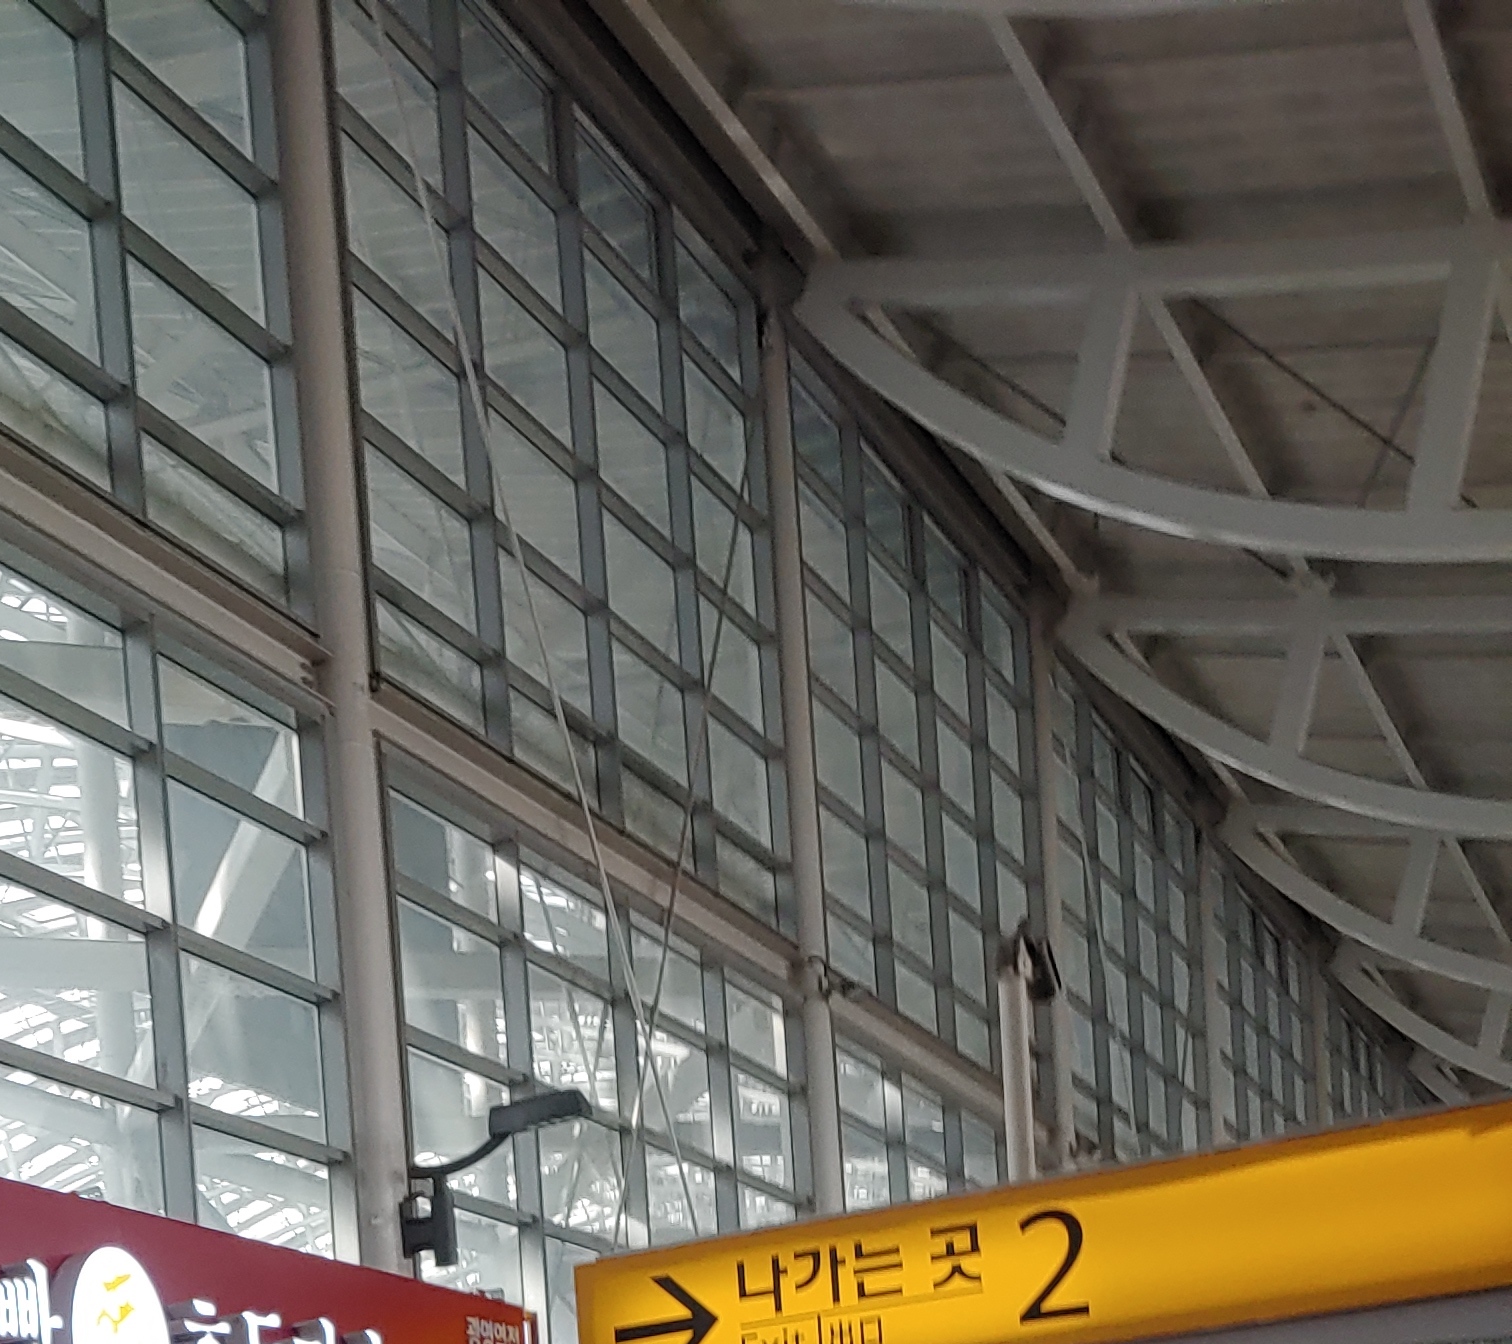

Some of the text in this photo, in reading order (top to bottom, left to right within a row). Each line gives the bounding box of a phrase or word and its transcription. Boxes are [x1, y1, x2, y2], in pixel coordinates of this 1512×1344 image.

[736, 1210, 1091, 1325] 나가는 곳 2
